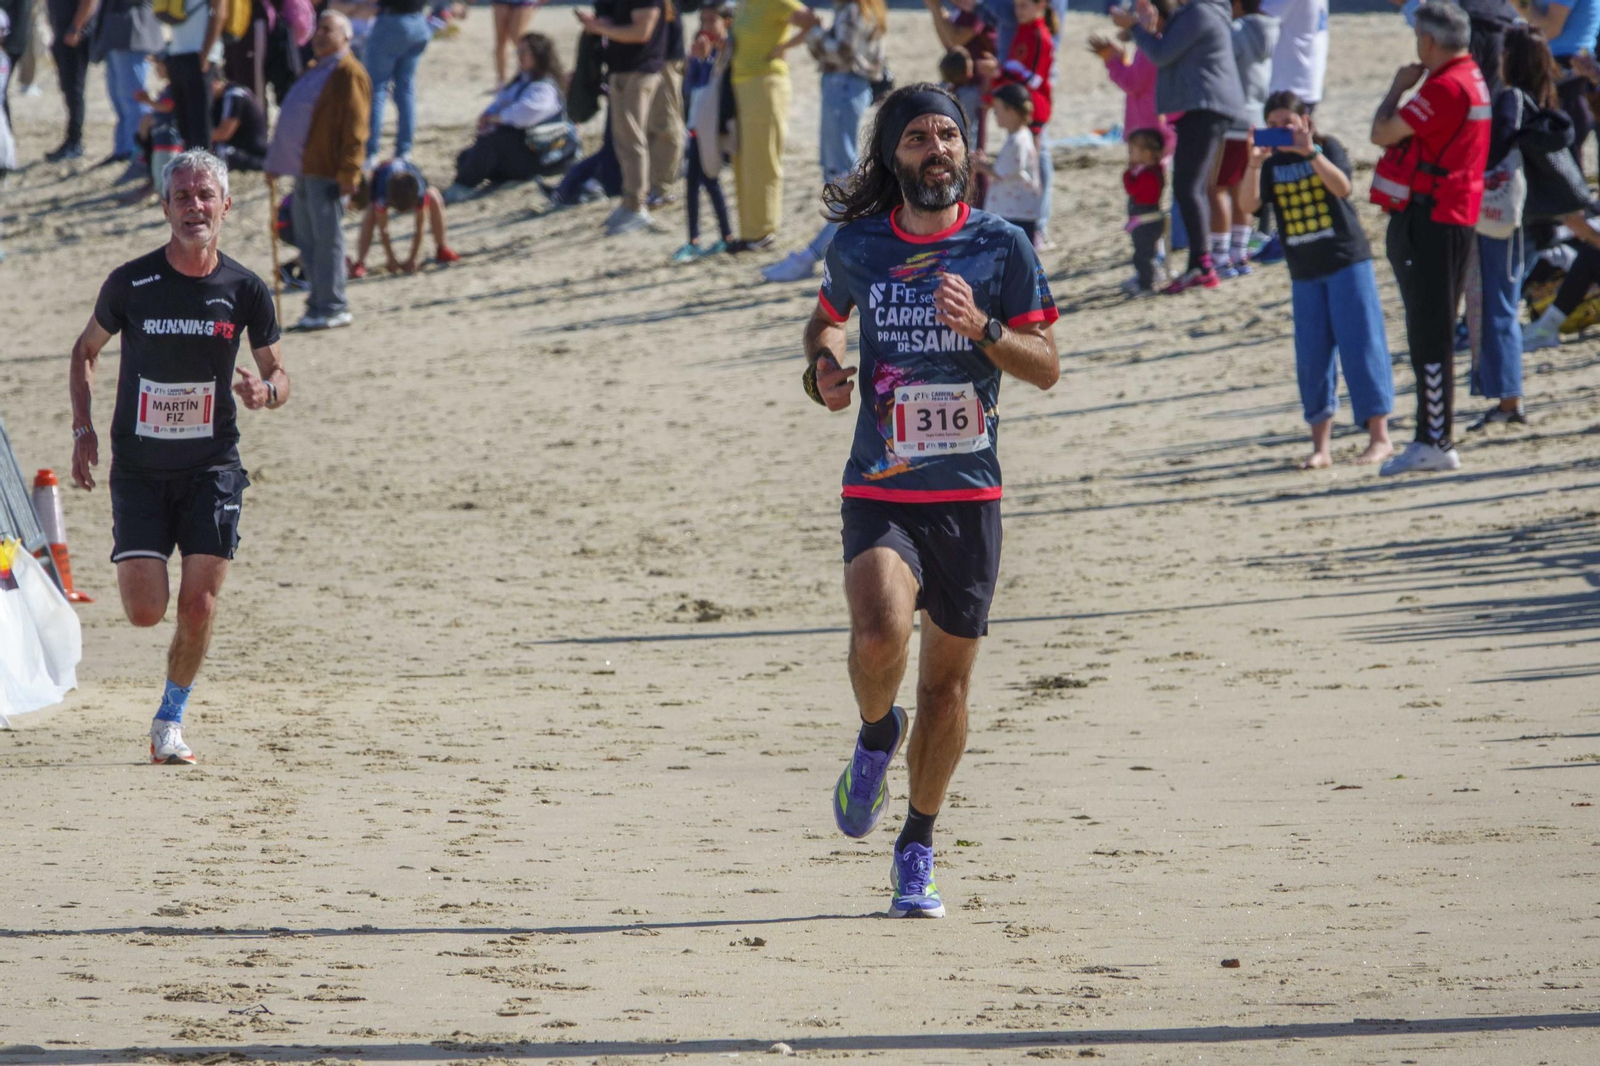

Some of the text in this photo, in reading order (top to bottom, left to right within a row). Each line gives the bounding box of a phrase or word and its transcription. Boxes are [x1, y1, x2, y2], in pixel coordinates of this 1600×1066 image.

[877, 329, 973, 353] PRAIA DE SAMIL
[152, 399, 199, 411] MARTÍN
[166, 412, 184, 422] FIZ
[916, 407, 969, 431] 316
